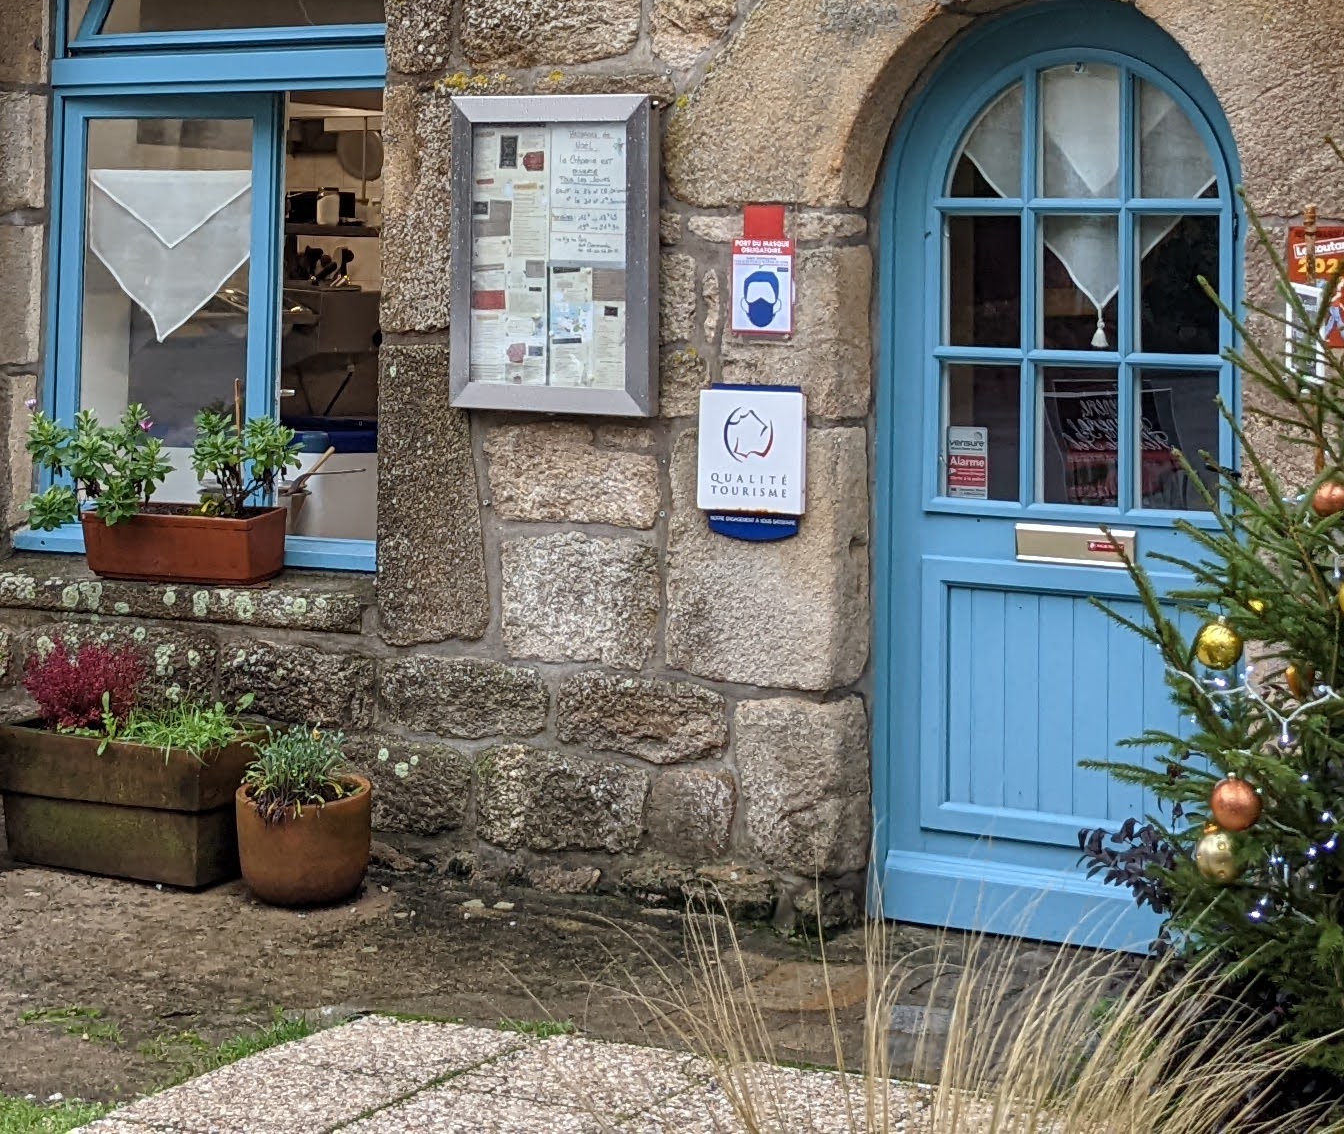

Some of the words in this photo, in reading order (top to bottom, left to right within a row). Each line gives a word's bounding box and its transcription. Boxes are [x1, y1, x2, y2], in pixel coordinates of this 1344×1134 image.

[949, 455, 985, 468] Alarme
[710, 472, 788, 486] QUALITÉ
[710, 484, 788, 499] TOURISME
